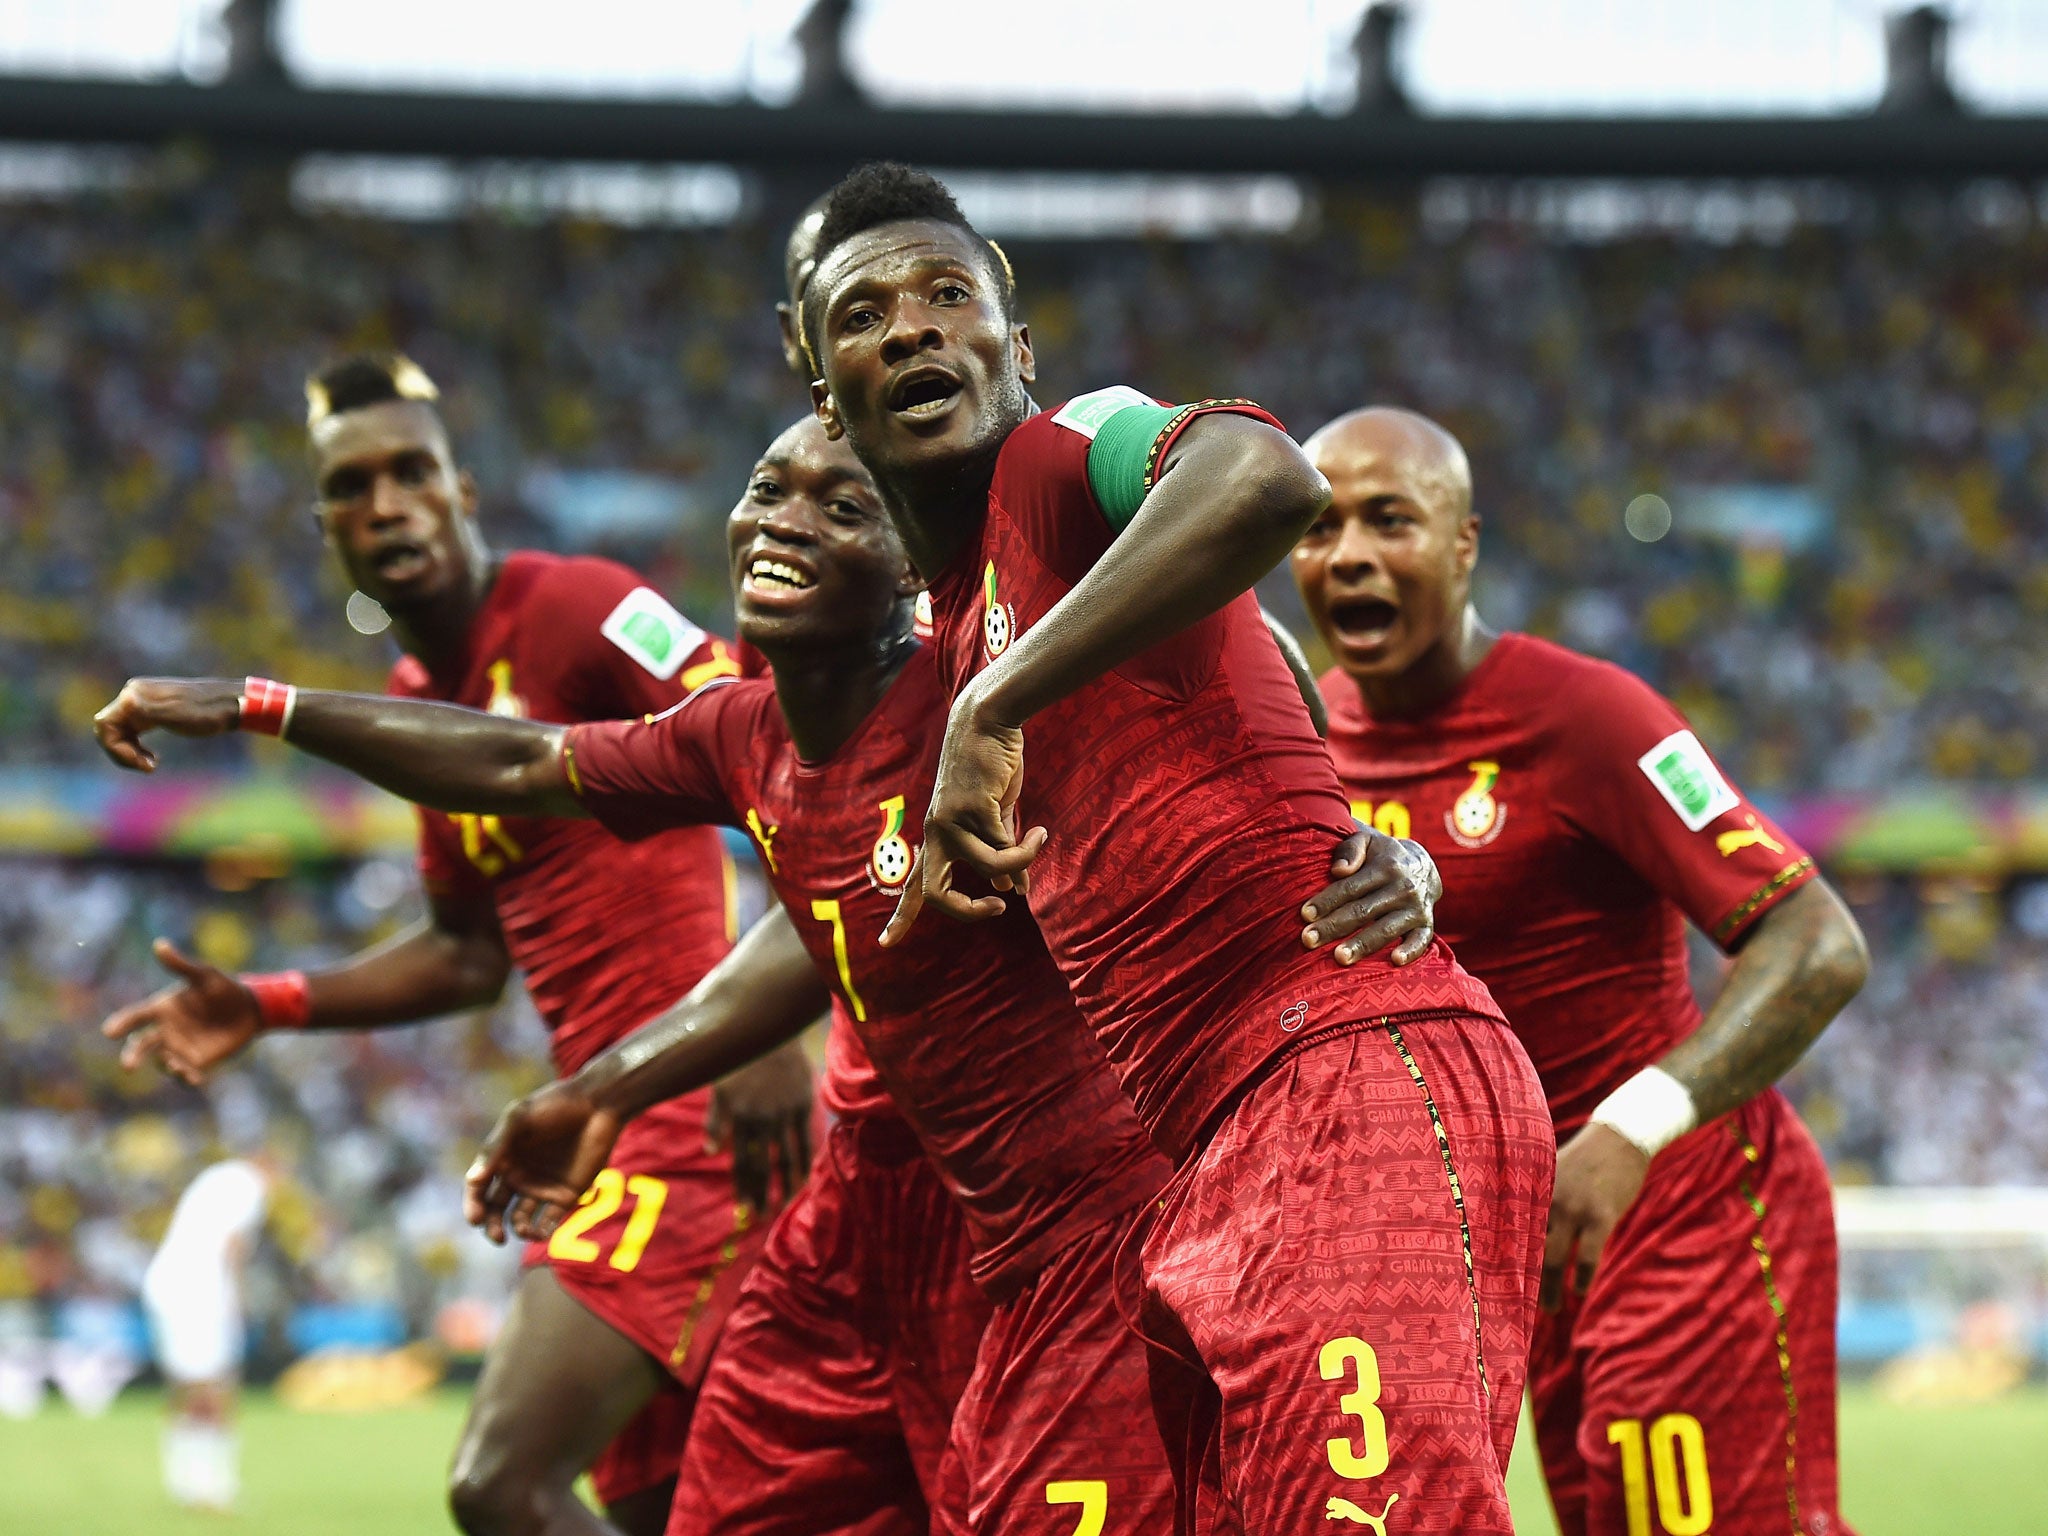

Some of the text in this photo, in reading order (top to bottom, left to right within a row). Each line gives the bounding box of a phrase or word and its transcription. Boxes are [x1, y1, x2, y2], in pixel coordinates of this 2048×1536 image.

[1123, 744, 1165, 779] BLACK
[811, 899, 864, 1021] 7
[1292, 977, 1345, 1002] BLACK
[1283, 1014, 1301, 1026] POWER
[1366, 1107, 1411, 1124] GHANA
[547, 1168, 668, 1273] 21
[1304, 1264, 1341, 1281] STARS
[1389, 1258, 1435, 1274] GHANA
[1318, 1335, 1391, 1479] 3
[1411, 1411, 1455, 1427] GHANA
[1606, 1412, 1713, 1536] 10
